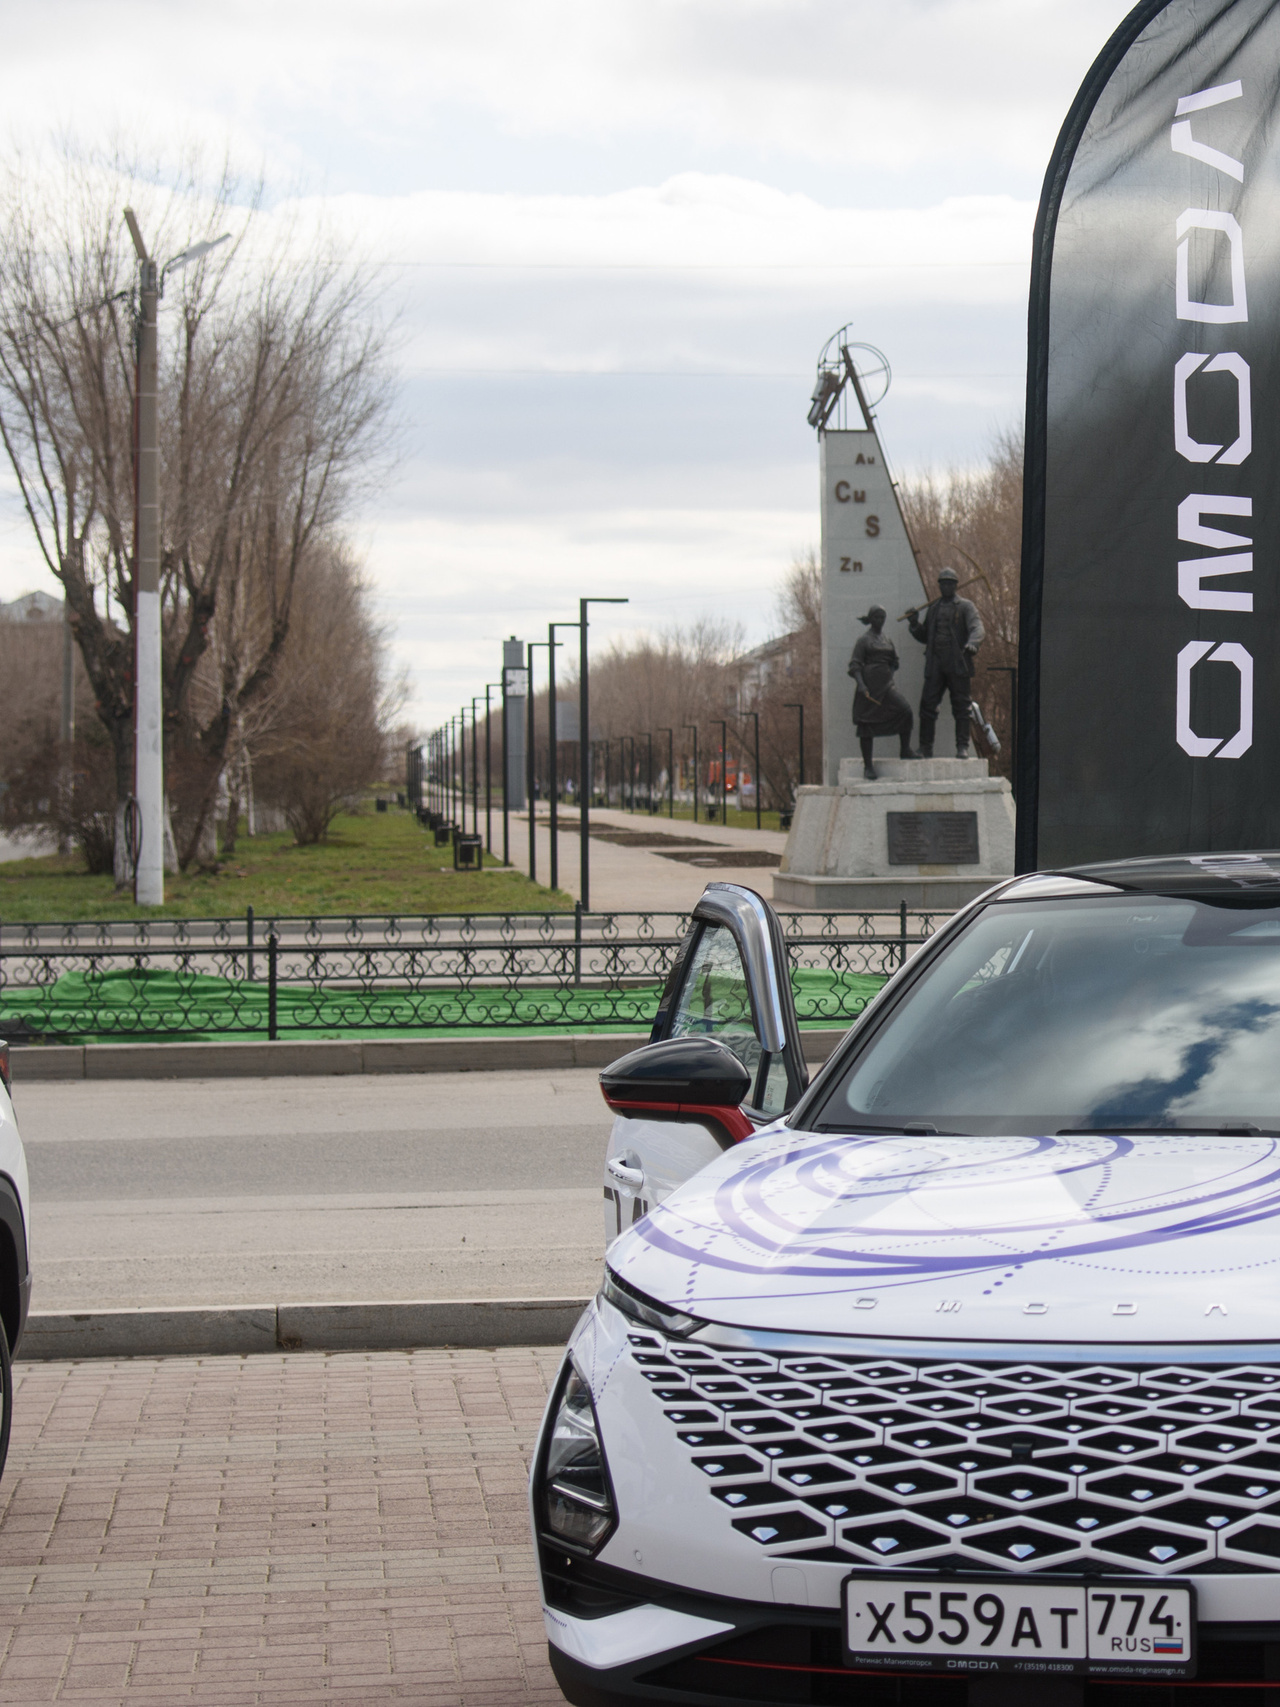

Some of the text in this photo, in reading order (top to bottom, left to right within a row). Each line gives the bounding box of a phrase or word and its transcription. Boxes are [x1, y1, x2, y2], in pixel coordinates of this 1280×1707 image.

[1171, 79, 1253, 759] OMODA
[855, 453, 875, 465] Au
[835, 480, 866, 503] Cu
[865, 515, 880, 538] S
[840, 556, 863, 572] Zn
[852, 1297, 1229, 1316] OMODA
[1091, 1593, 1175, 1637] 774
[1111, 1637, 1152, 1653] RUS
[884, 1657, 932, 1667] Магнитогорск
[1024, 1662, 1047, 1671] (3519)
[1047, 1663, 1074, 1672] 418300
